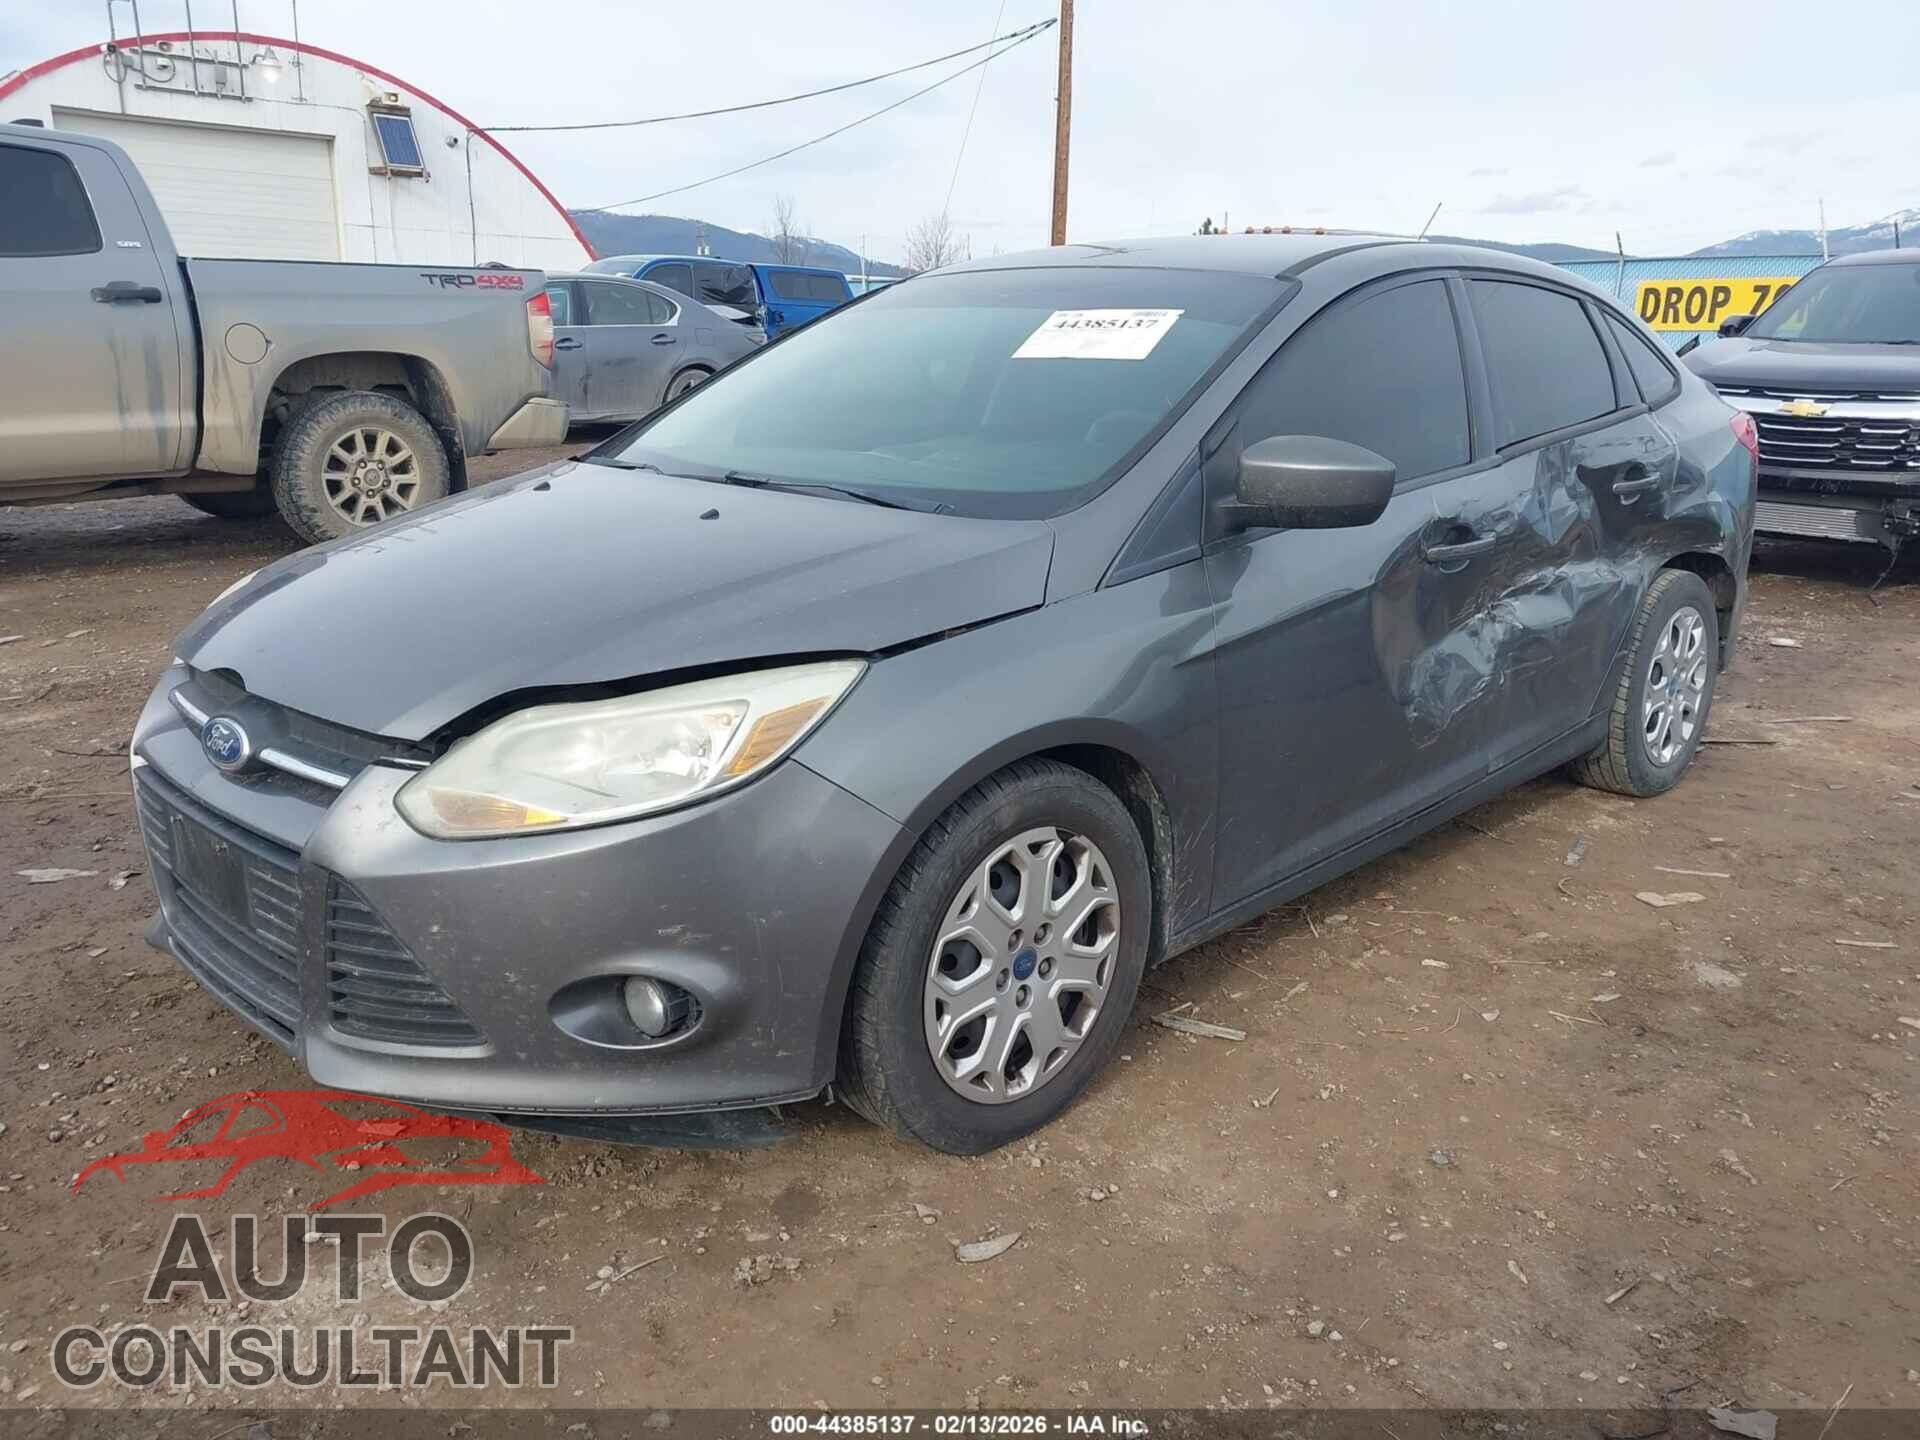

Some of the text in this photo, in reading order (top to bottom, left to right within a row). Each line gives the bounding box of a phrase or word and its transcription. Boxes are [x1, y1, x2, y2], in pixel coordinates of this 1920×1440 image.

[1640, 286, 1731, 324] DROP
[1055, 319, 1159, 329] 44385137
[206, 723, 234, 757] Ford
